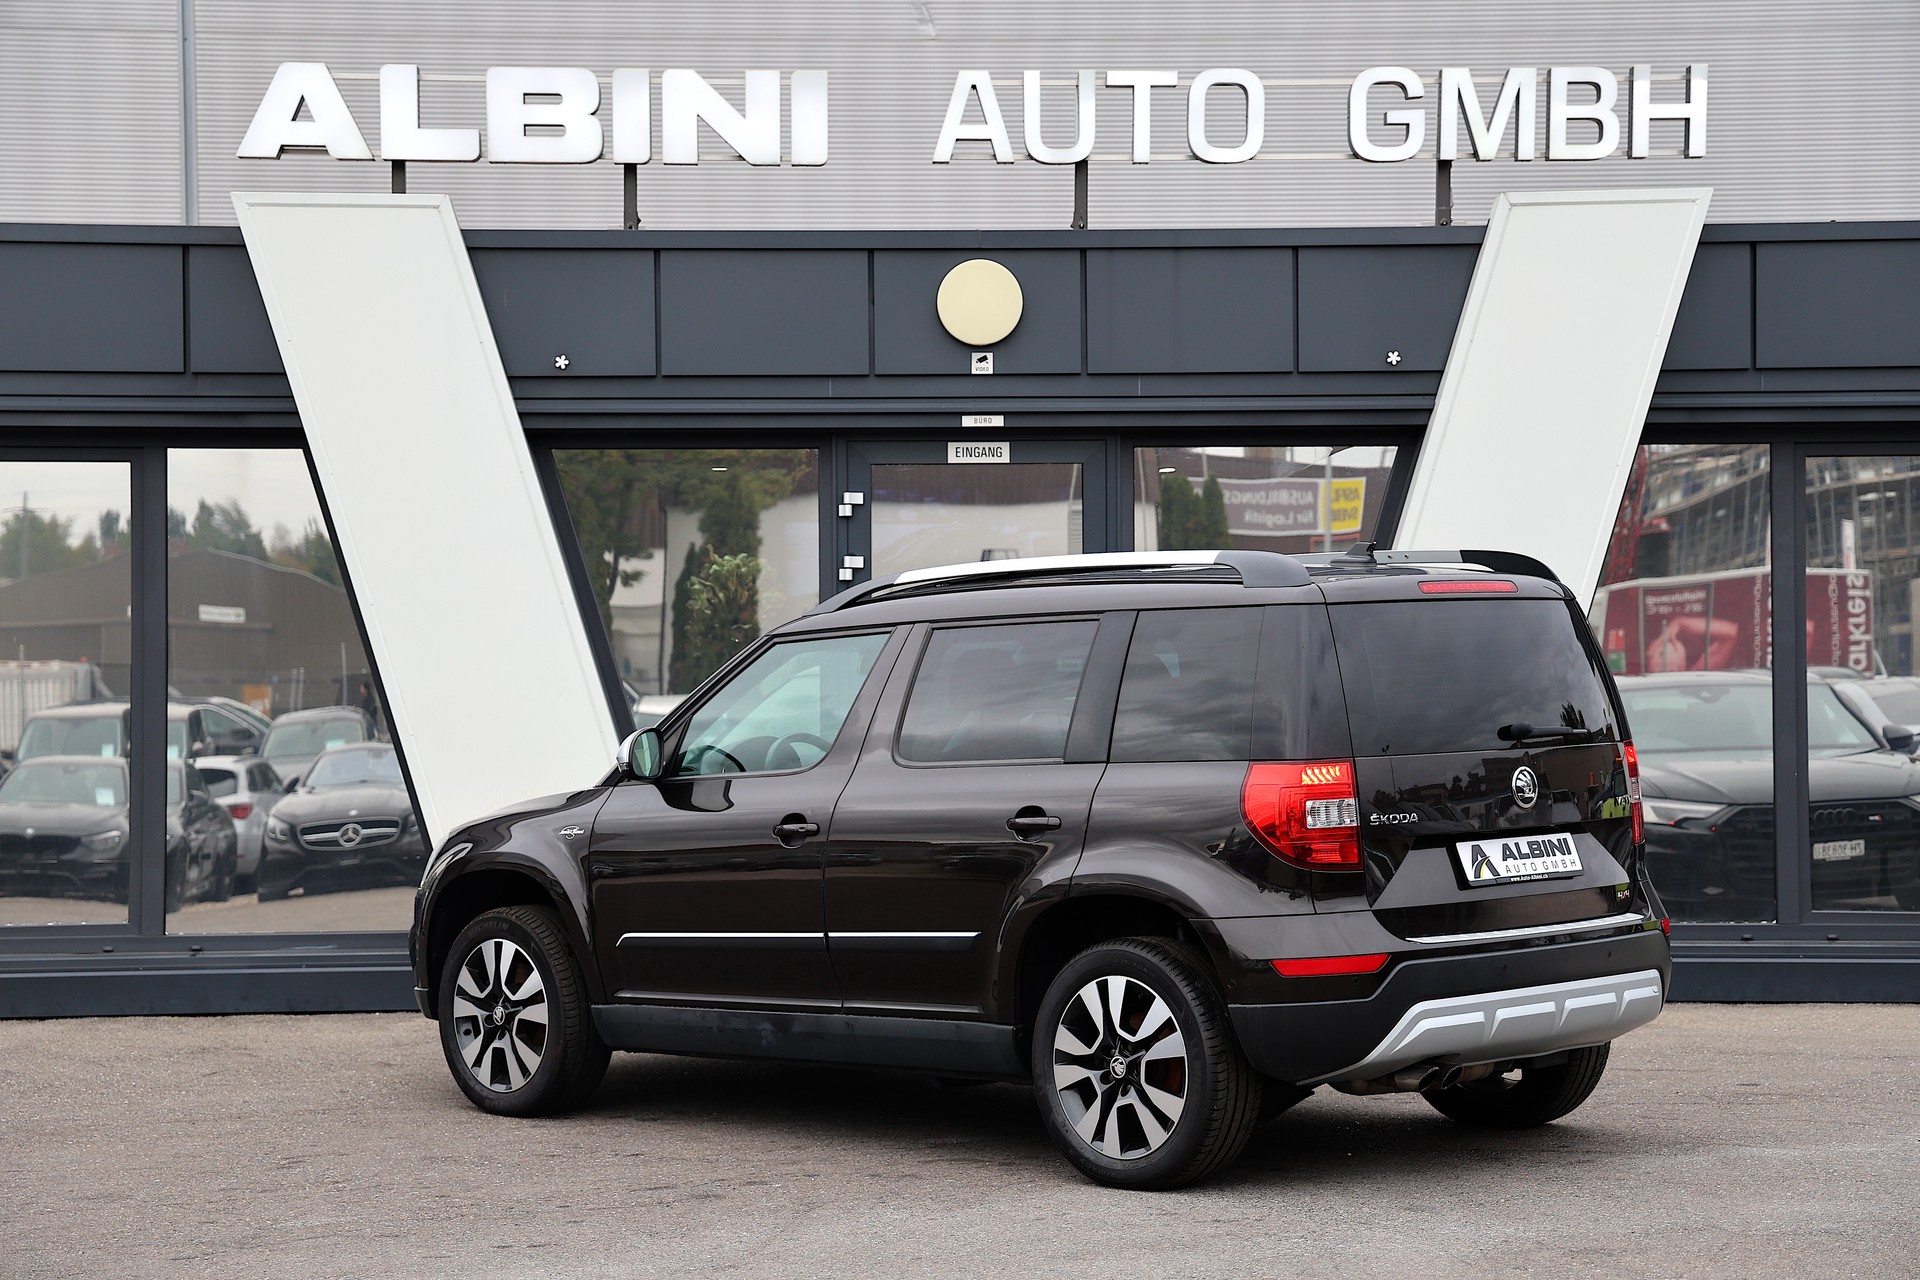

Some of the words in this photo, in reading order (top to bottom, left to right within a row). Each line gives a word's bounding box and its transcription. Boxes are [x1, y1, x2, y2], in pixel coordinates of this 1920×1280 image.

[236, 62, 828, 166] ALBINI
[932, 67, 1266, 165] AUTO
[1348, 63, 1709, 163] GMBH
[973, 416, 993, 425] BÜRO
[955, 446, 1003, 458] EINGANG
[1369, 812, 1419, 826] ŠKODA
[1501, 837, 1572, 861] ALBINI
[1505, 862, 1538, 874] AUTO
[1542, 859, 1577, 871] GMBH
